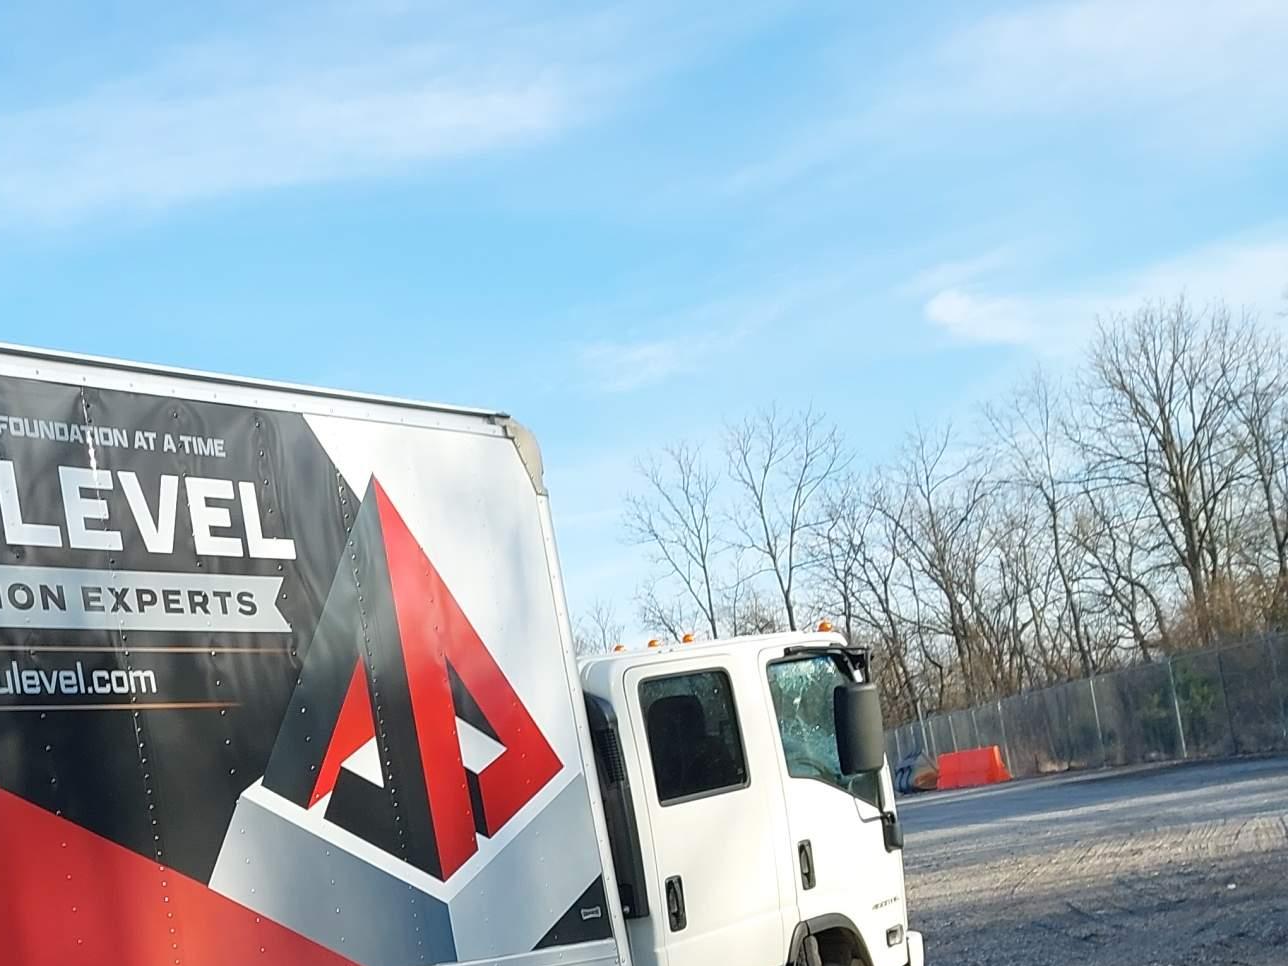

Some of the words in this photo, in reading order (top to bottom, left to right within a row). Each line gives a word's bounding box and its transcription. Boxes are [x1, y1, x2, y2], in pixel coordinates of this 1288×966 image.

[134, 431, 157, 451] AT
[163, 434, 177, 453] A
[179, 435, 226, 458] TIME
[82, 586, 259, 617] EXPERTS
